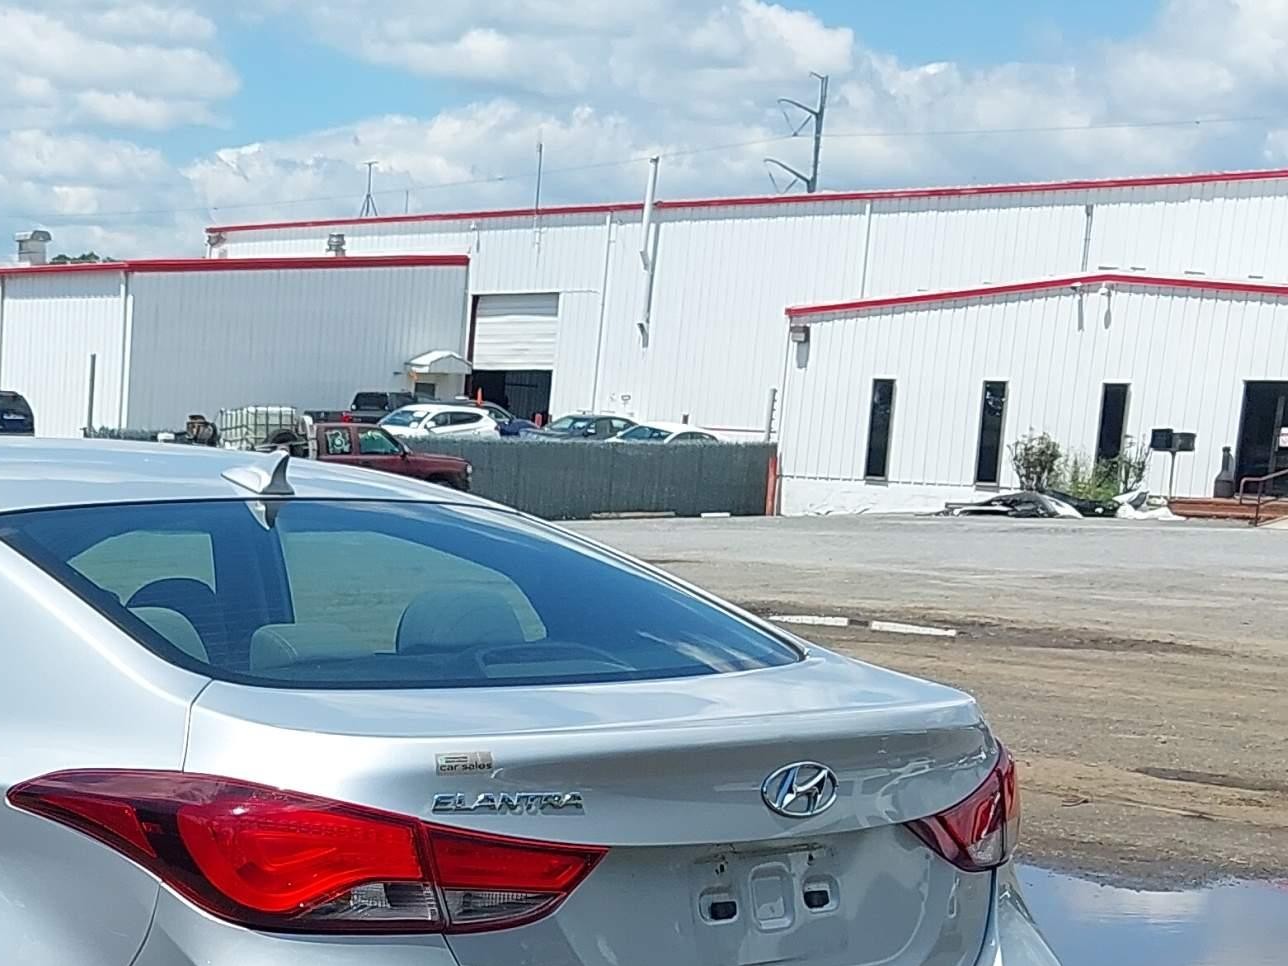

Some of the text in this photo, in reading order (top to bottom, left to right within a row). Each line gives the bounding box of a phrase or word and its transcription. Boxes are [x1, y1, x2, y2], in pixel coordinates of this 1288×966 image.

[439, 761, 493, 772] car sales
[432, 792, 585, 815] ELANTRA
